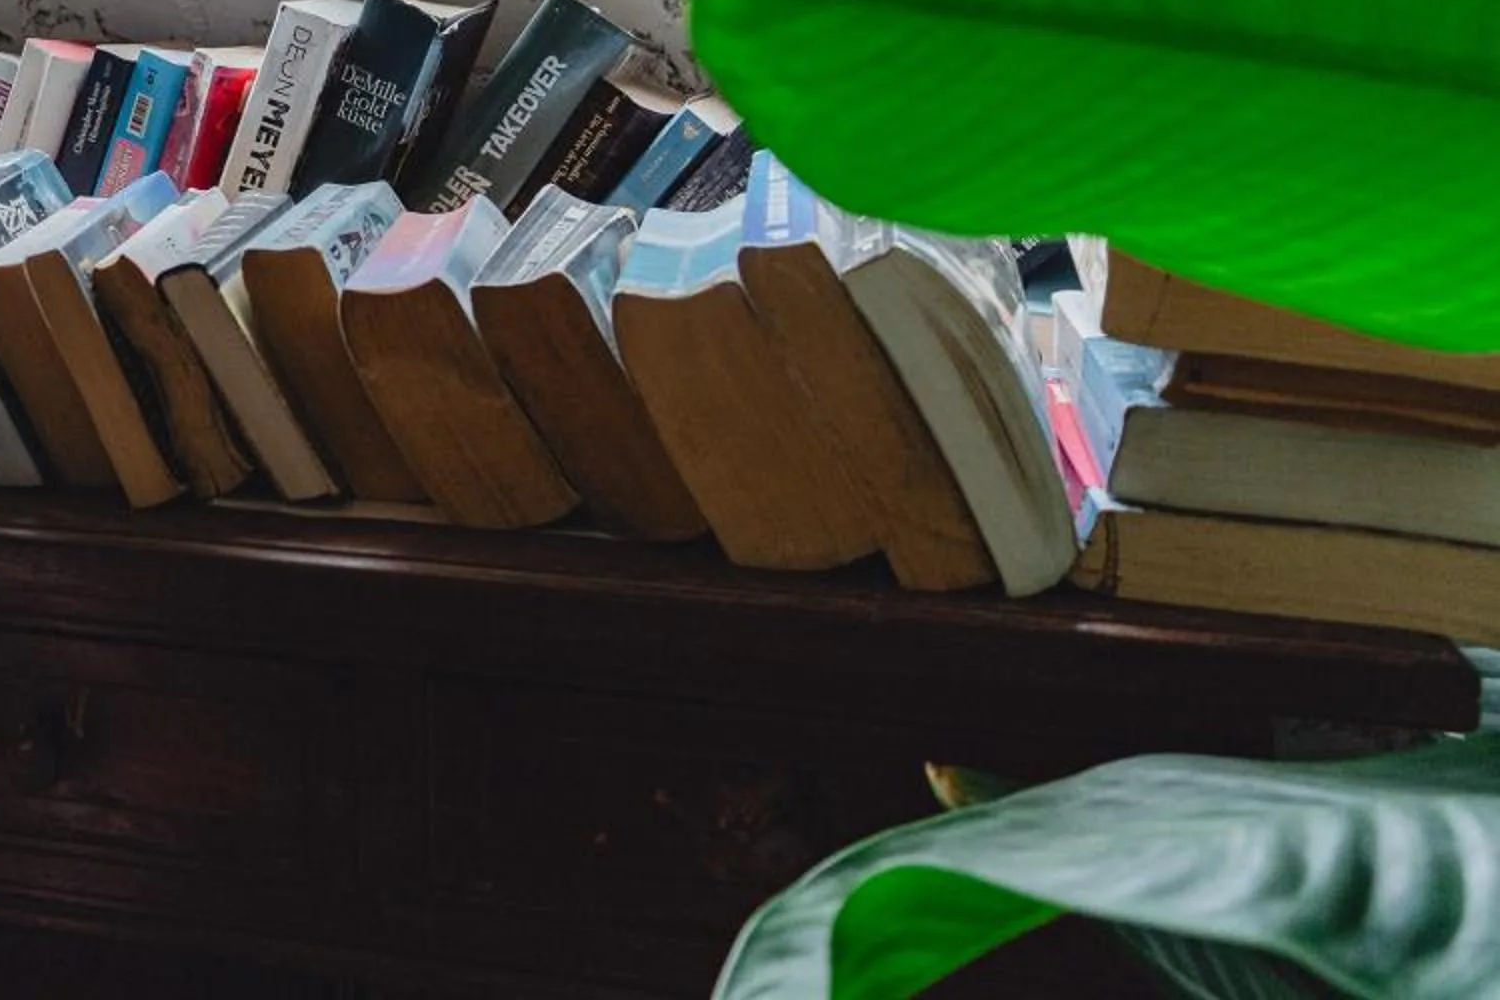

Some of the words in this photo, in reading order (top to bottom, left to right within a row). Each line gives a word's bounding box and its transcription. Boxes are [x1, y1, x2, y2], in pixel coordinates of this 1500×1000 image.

[282, 24, 311, 96] DEON
[341, 64, 407, 107] DeMille
[345, 88, 389, 118] Gold
[337, 102, 384, 134] küste
[429, 164, 476, 216] DLER
[480, 54, 569, 163] TAKEOVER
